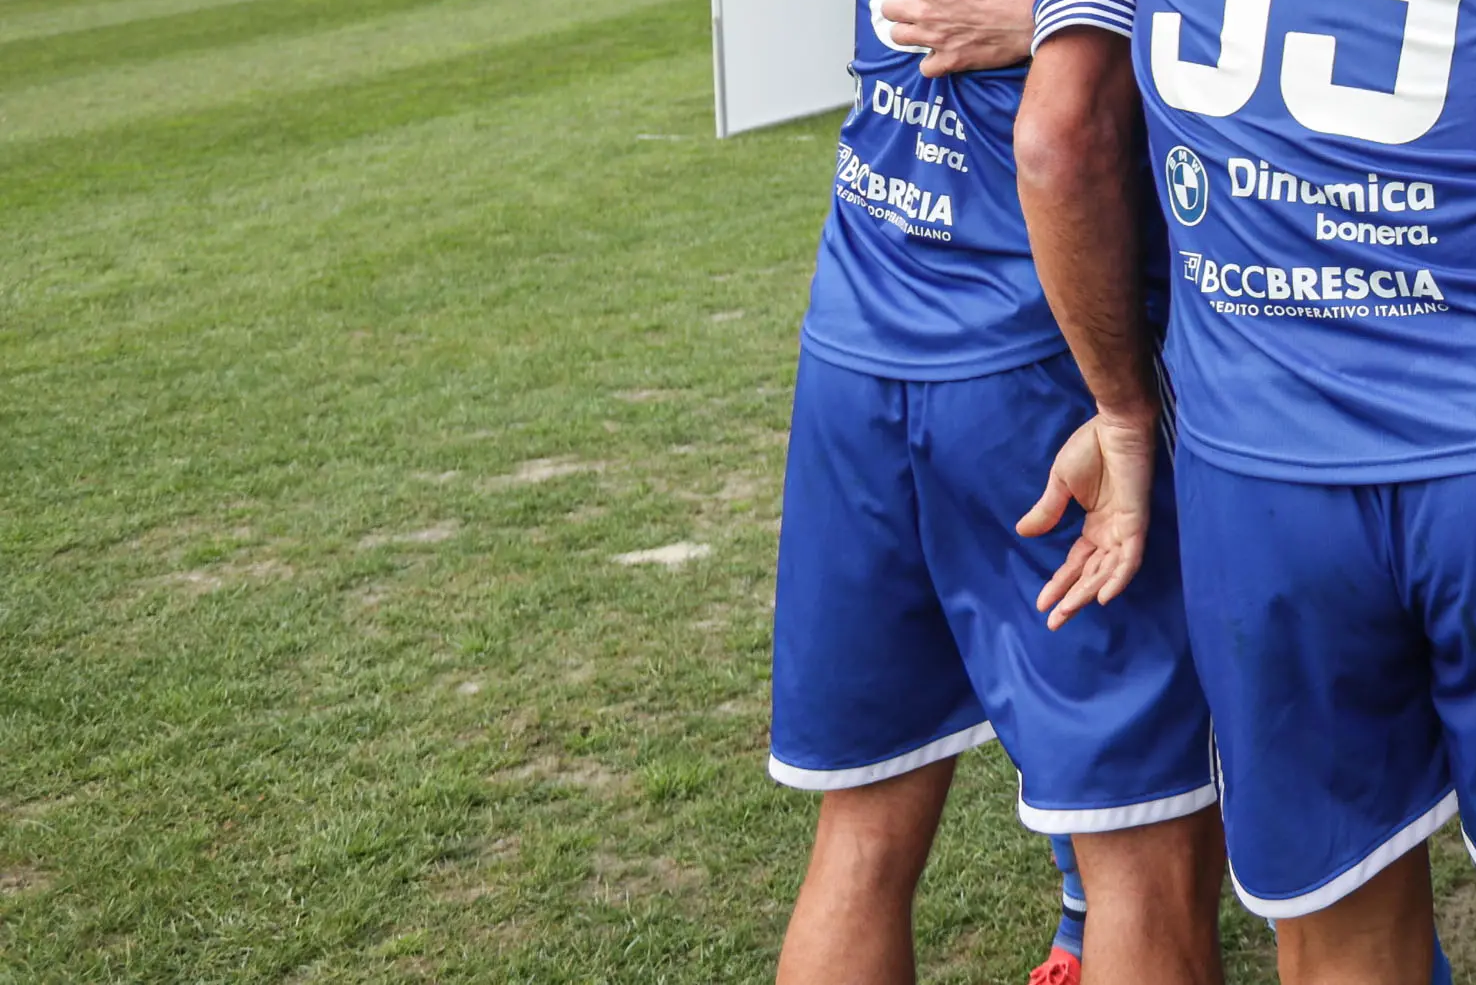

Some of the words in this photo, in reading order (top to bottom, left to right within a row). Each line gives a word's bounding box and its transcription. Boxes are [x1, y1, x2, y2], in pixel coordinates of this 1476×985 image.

[1315, 213, 1439, 246] bonera.
[1200, 259, 1445, 301] BCCBRESCIA
[1263, 303, 1370, 319] COOPERATIVO
[1374, 301, 1450, 318] ITALIANO
